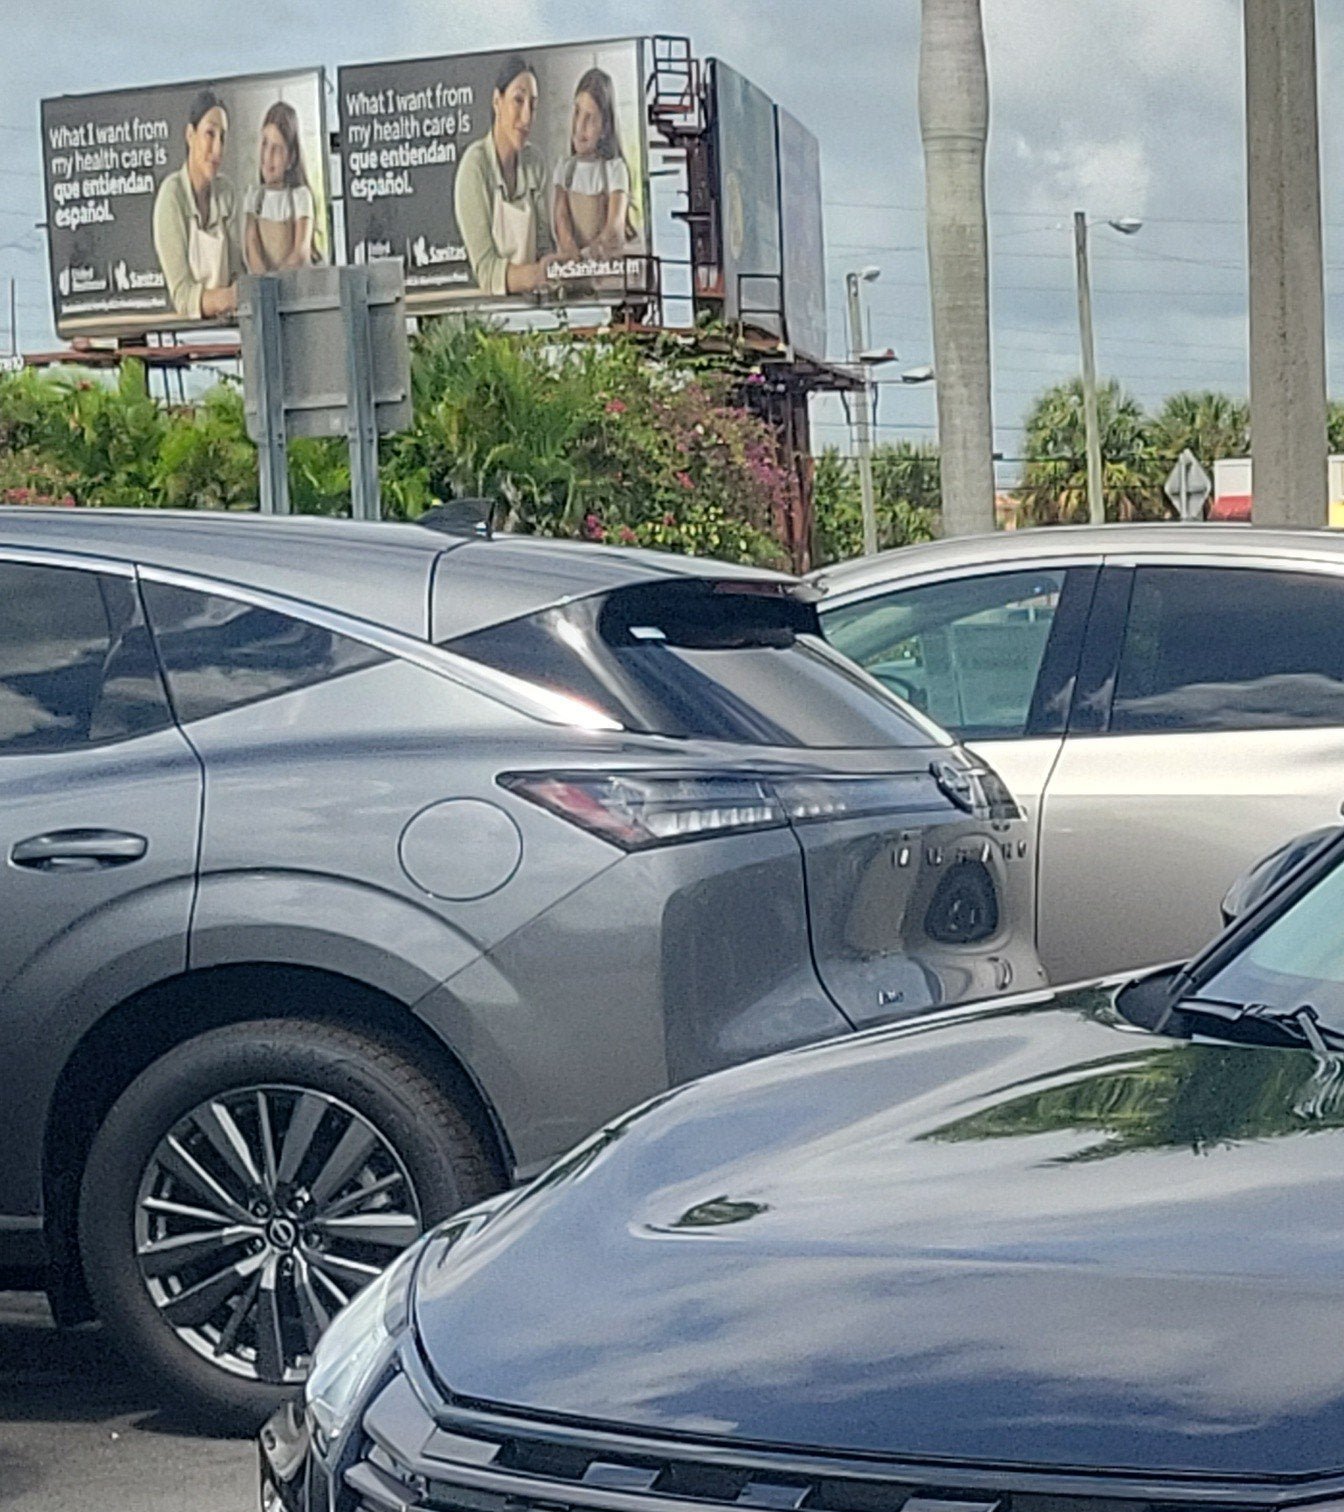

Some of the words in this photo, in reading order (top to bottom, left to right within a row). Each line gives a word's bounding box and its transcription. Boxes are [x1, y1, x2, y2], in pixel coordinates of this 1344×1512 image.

[347, 91, 385, 116] What
[387, 89, 394, 114] I
[397, 88, 433, 112] want
[436, 82, 473, 106] from
[50, 126, 85, 149] What
[87, 122, 95, 146] I
[96, 122, 131, 144] want
[133, 117, 168, 140] from
[349, 124, 371, 148] my
[373, 115, 420, 142] health
[423, 117, 455, 137] care
[458, 110, 470, 133] is
[52, 156, 73, 179] my
[75, 147, 119, 173] health
[121, 151, 153, 169] care
[155, 143, 167, 165] is
[350, 151, 378, 175] que
[380, 140, 456, 168] entiendan
[54, 182, 80, 205] que
[82, 171, 154, 198] entiendan
[350, 171, 413, 202] español.
[55, 199, 114, 231] español.
[430, 245, 467, 263] Sanitas
